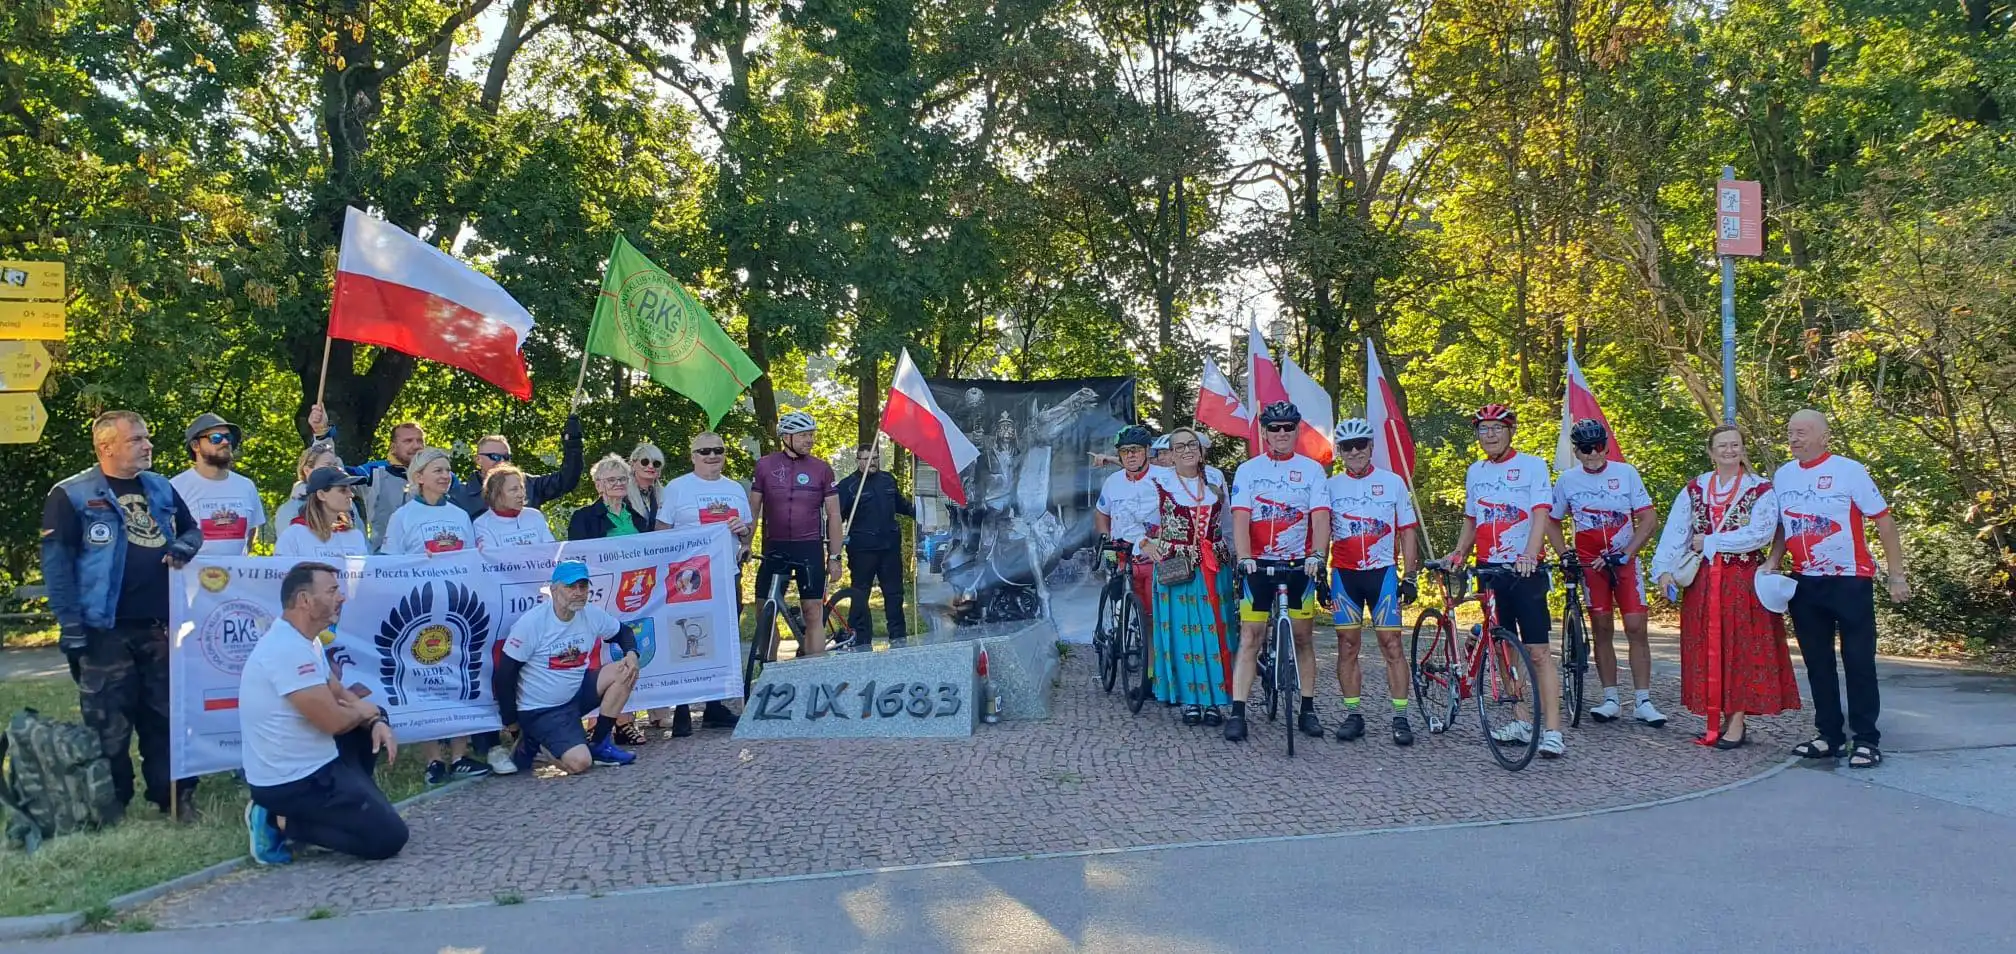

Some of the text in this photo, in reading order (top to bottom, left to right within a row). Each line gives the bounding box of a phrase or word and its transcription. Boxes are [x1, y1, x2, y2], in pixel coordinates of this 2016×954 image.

[237, 567, 259, 579] VII
[375, 568, 408, 579] Poczta
[412, 565, 468, 579] Królewska
[599, 549, 641, 563] 1000-lecie
[644, 542, 686, 557] koronacji
[753, 680, 961, 721] 12 IX 1683
